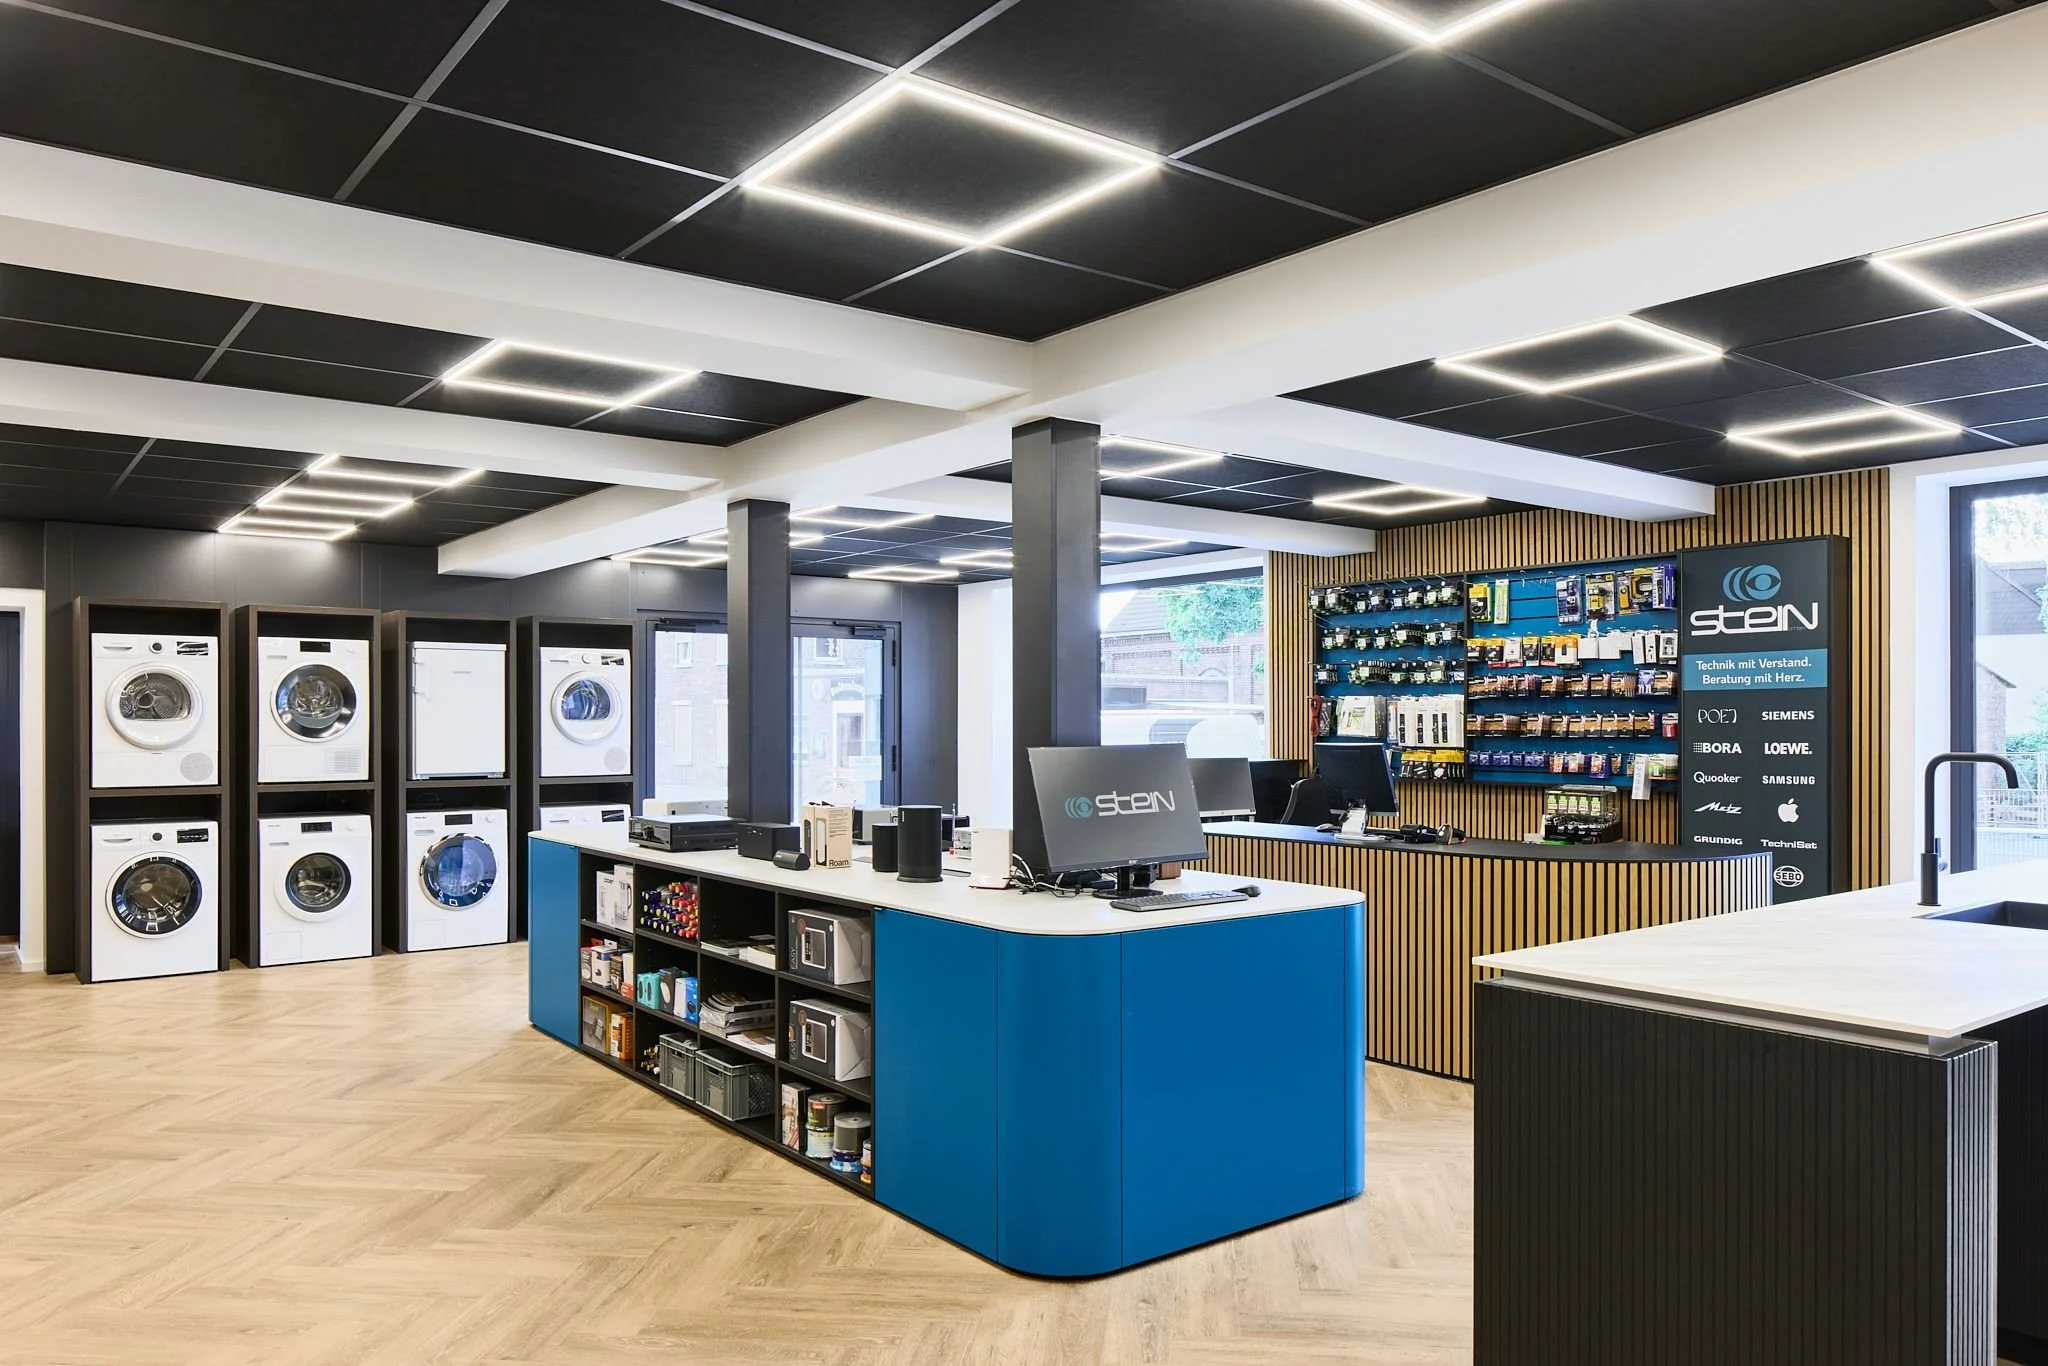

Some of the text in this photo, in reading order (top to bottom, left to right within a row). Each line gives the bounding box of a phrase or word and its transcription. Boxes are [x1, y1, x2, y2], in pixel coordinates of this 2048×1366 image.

[1696, 657, 1812, 671] Technik mit Verstand.
[1702, 672, 1806, 686] Beratung mit Herz.
[1761, 710, 1815, 721] SIEMENS
[1702, 742, 1742, 754] BORA
[1764, 742, 1813, 755] LOEWE.
[1693, 771, 1741, 785] Quooker
[1762, 775, 1816, 785] SAMSUNG
[1694, 801, 1742, 815] Metz
[1693, 835, 1743, 845] GRUNDIG
[1760, 839, 1818, 850] TechniSat
[829, 859, 849, 867] Roam
[1775, 872, 1803, 882] SEBO
